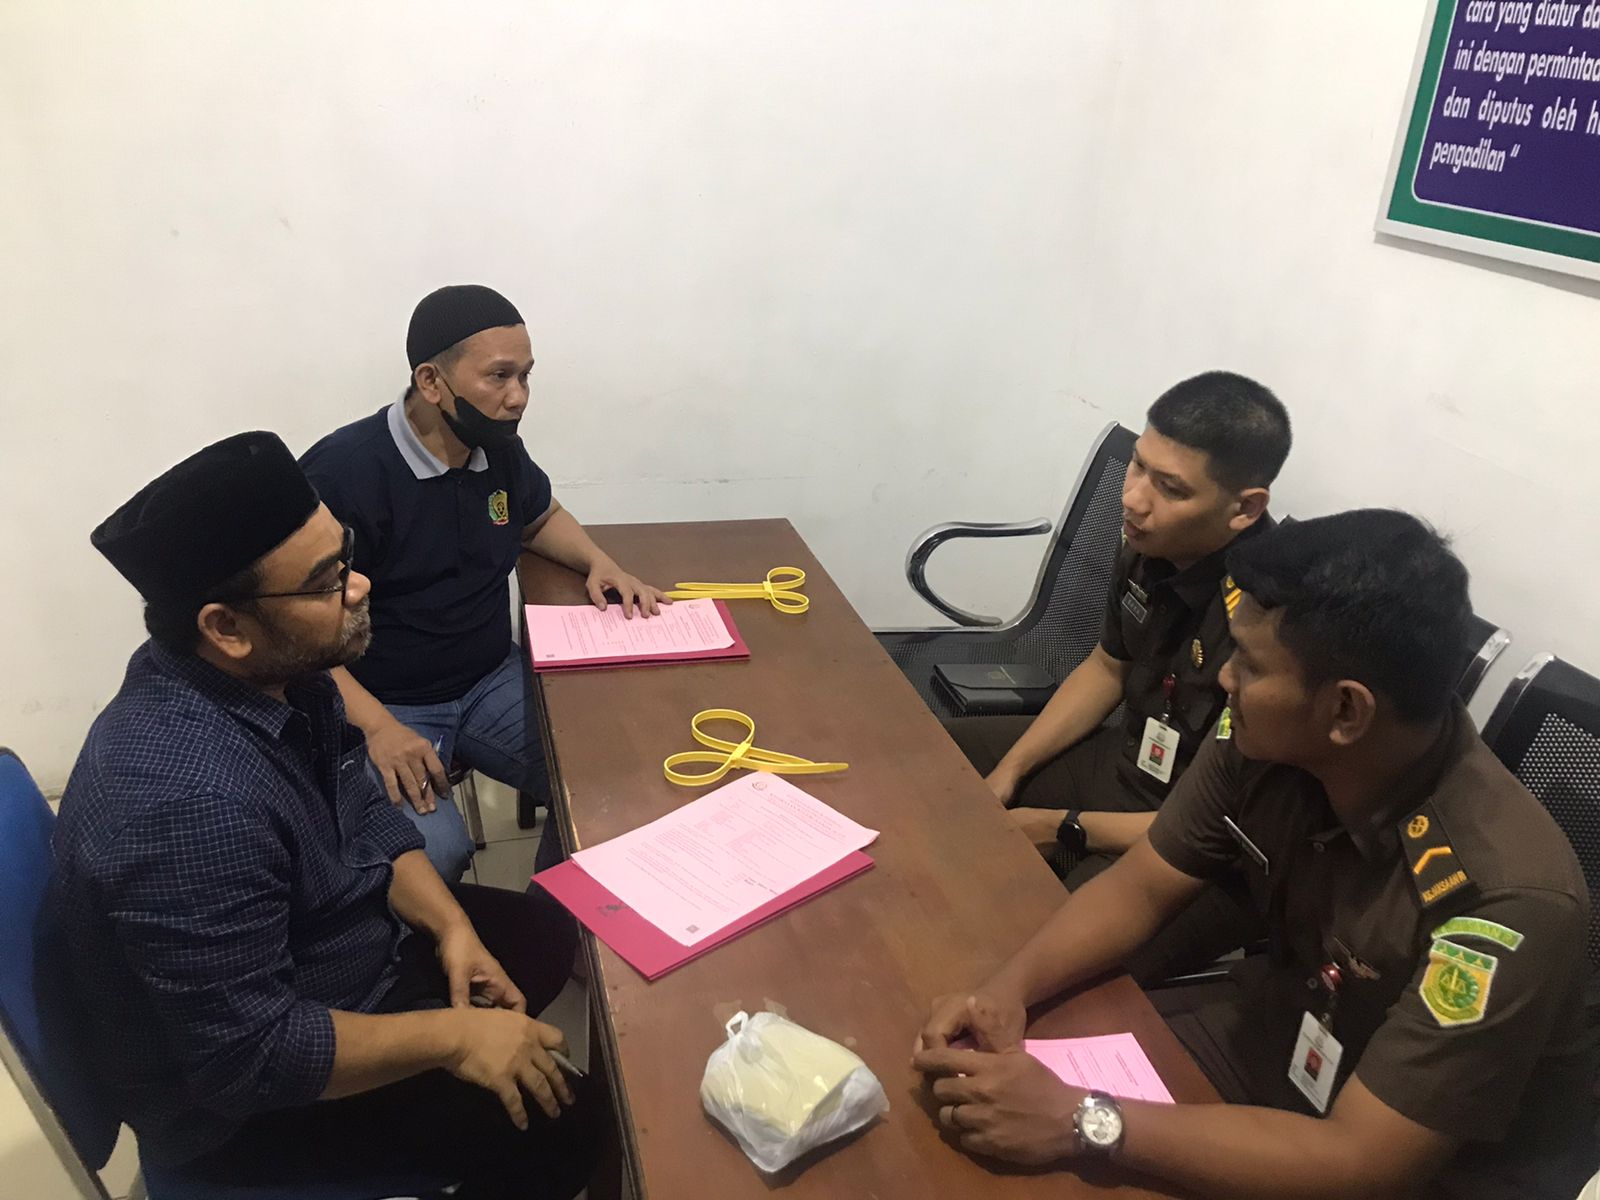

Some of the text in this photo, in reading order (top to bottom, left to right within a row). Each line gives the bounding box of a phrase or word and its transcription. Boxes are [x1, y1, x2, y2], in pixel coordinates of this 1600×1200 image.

[1465, 0, 1600, 33] cara yang diatur da
[1453, 39, 1600, 84] ini dengan permintaa
[1443, 86, 1600, 135] dan diputus oleh h
[1429, 138, 1506, 173] pengadilan
